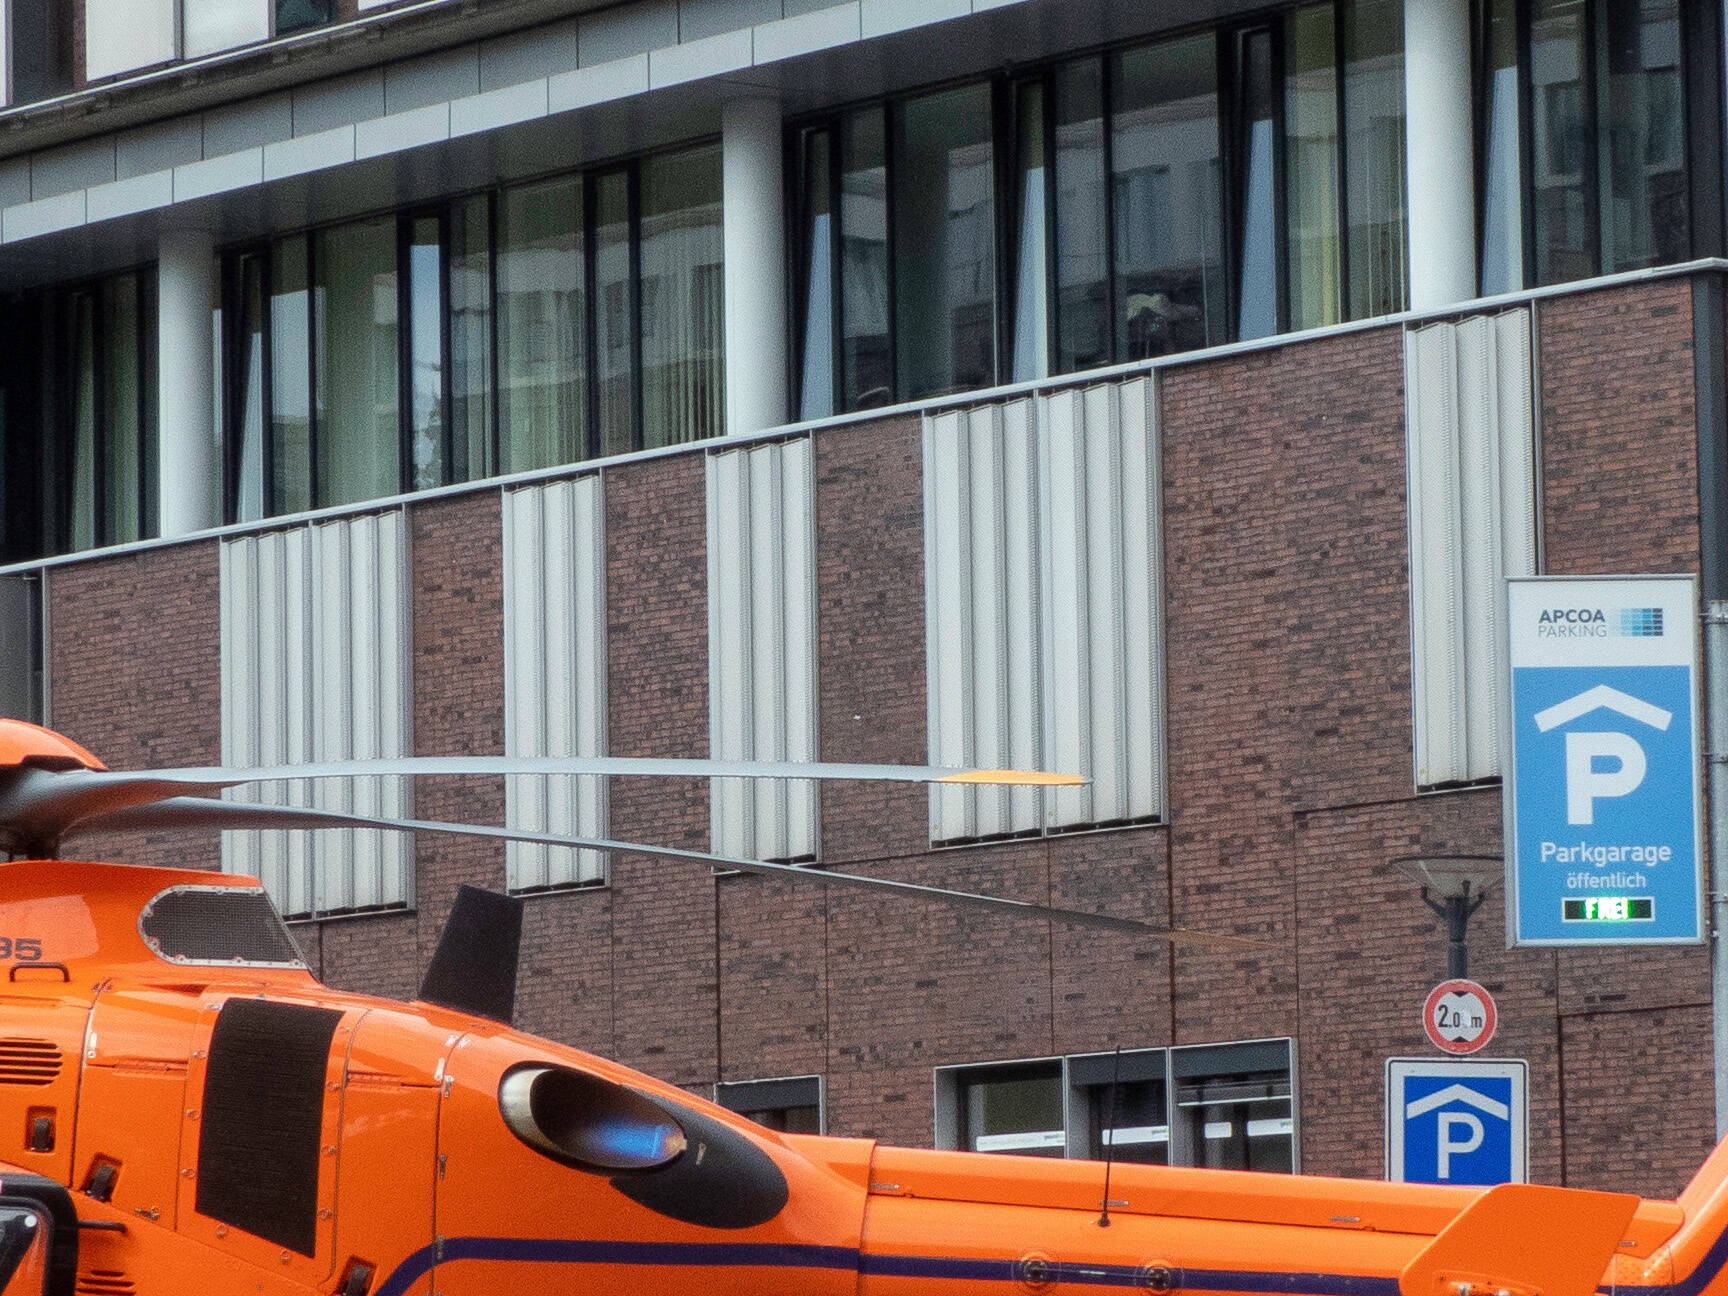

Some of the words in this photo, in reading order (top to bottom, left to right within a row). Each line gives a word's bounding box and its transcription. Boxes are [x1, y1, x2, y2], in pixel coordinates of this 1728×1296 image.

[1538, 609, 1606, 624] APCOA
[1538, 625, 1608, 638] PARKING
[1565, 732, 1647, 825] P
[1540, 841, 1672, 867] Parkgarage
[1566, 872, 1647, 889] öffentlich
[1584, 897, 1629, 920] FREI
[1470, 1016, 1483, 1028] m
[1437, 1112, 1485, 1180] P
